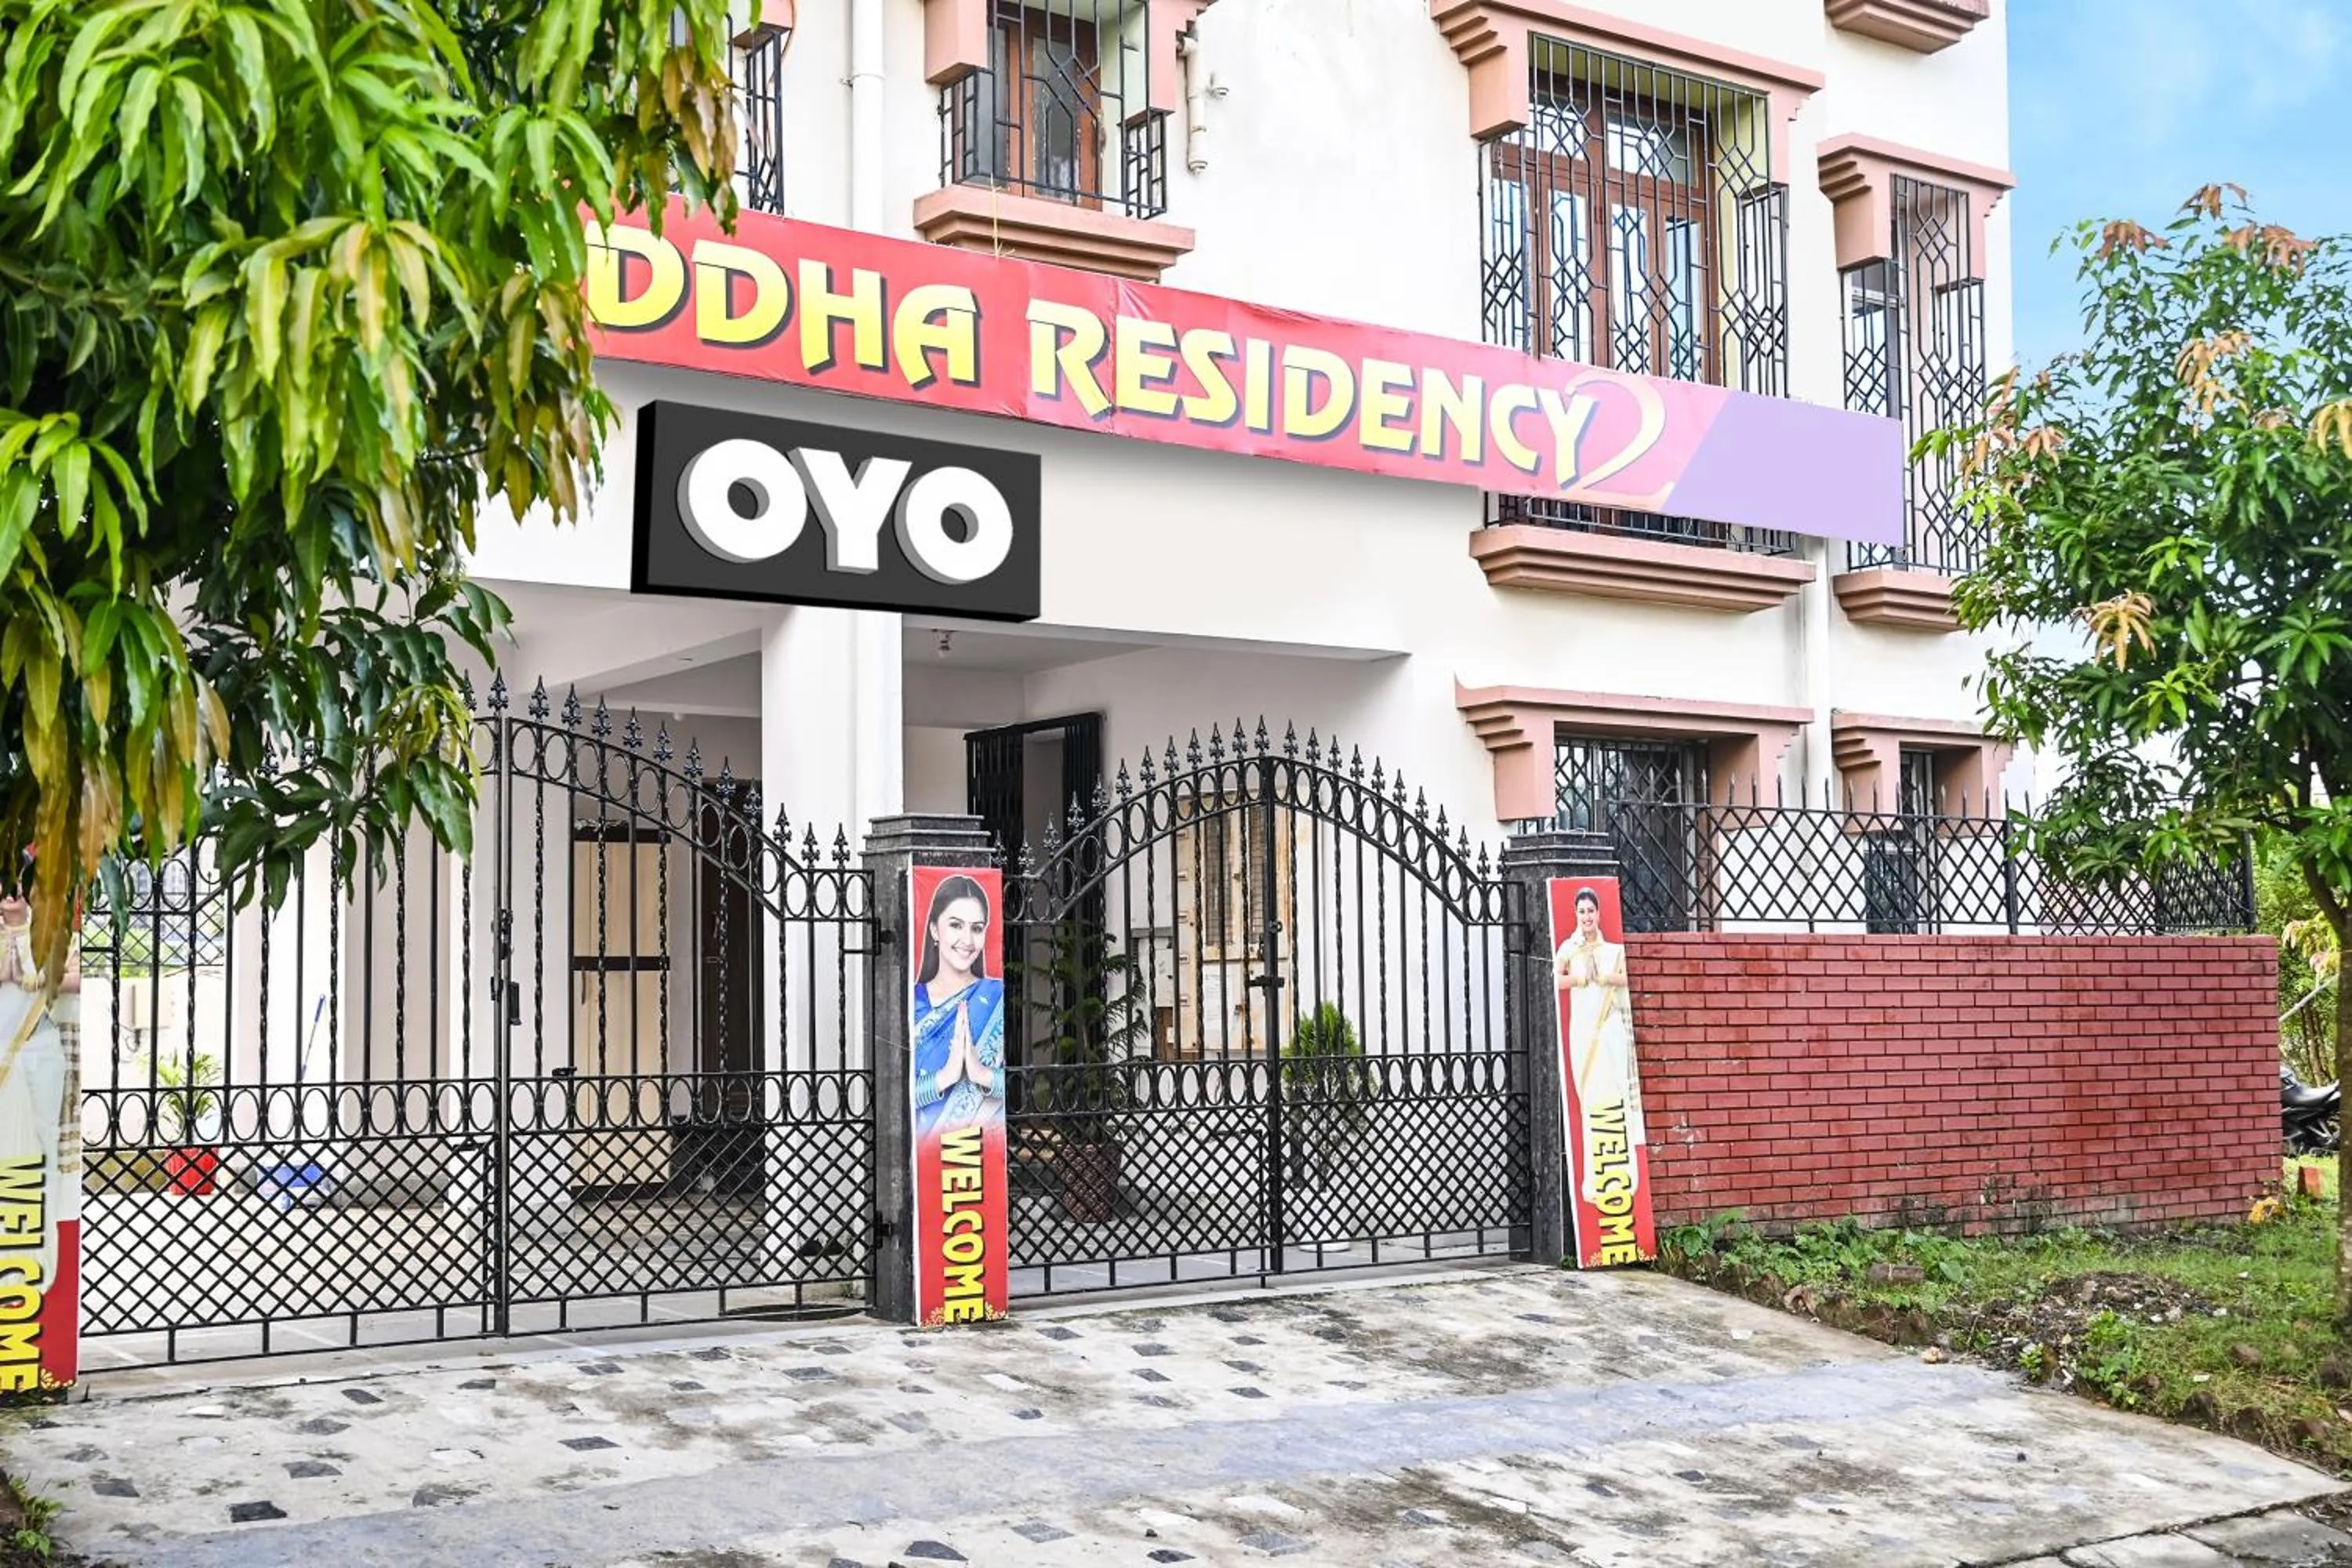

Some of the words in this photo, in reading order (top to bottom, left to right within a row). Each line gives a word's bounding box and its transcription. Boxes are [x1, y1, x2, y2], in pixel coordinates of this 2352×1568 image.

[1025, 298, 1599, 490] RESIDENCY
[677, 437, 1013, 585] OYO
[940, 1126, 986, 1324] WELCOME
[1588, 1096, 1639, 1267] WELCOME
